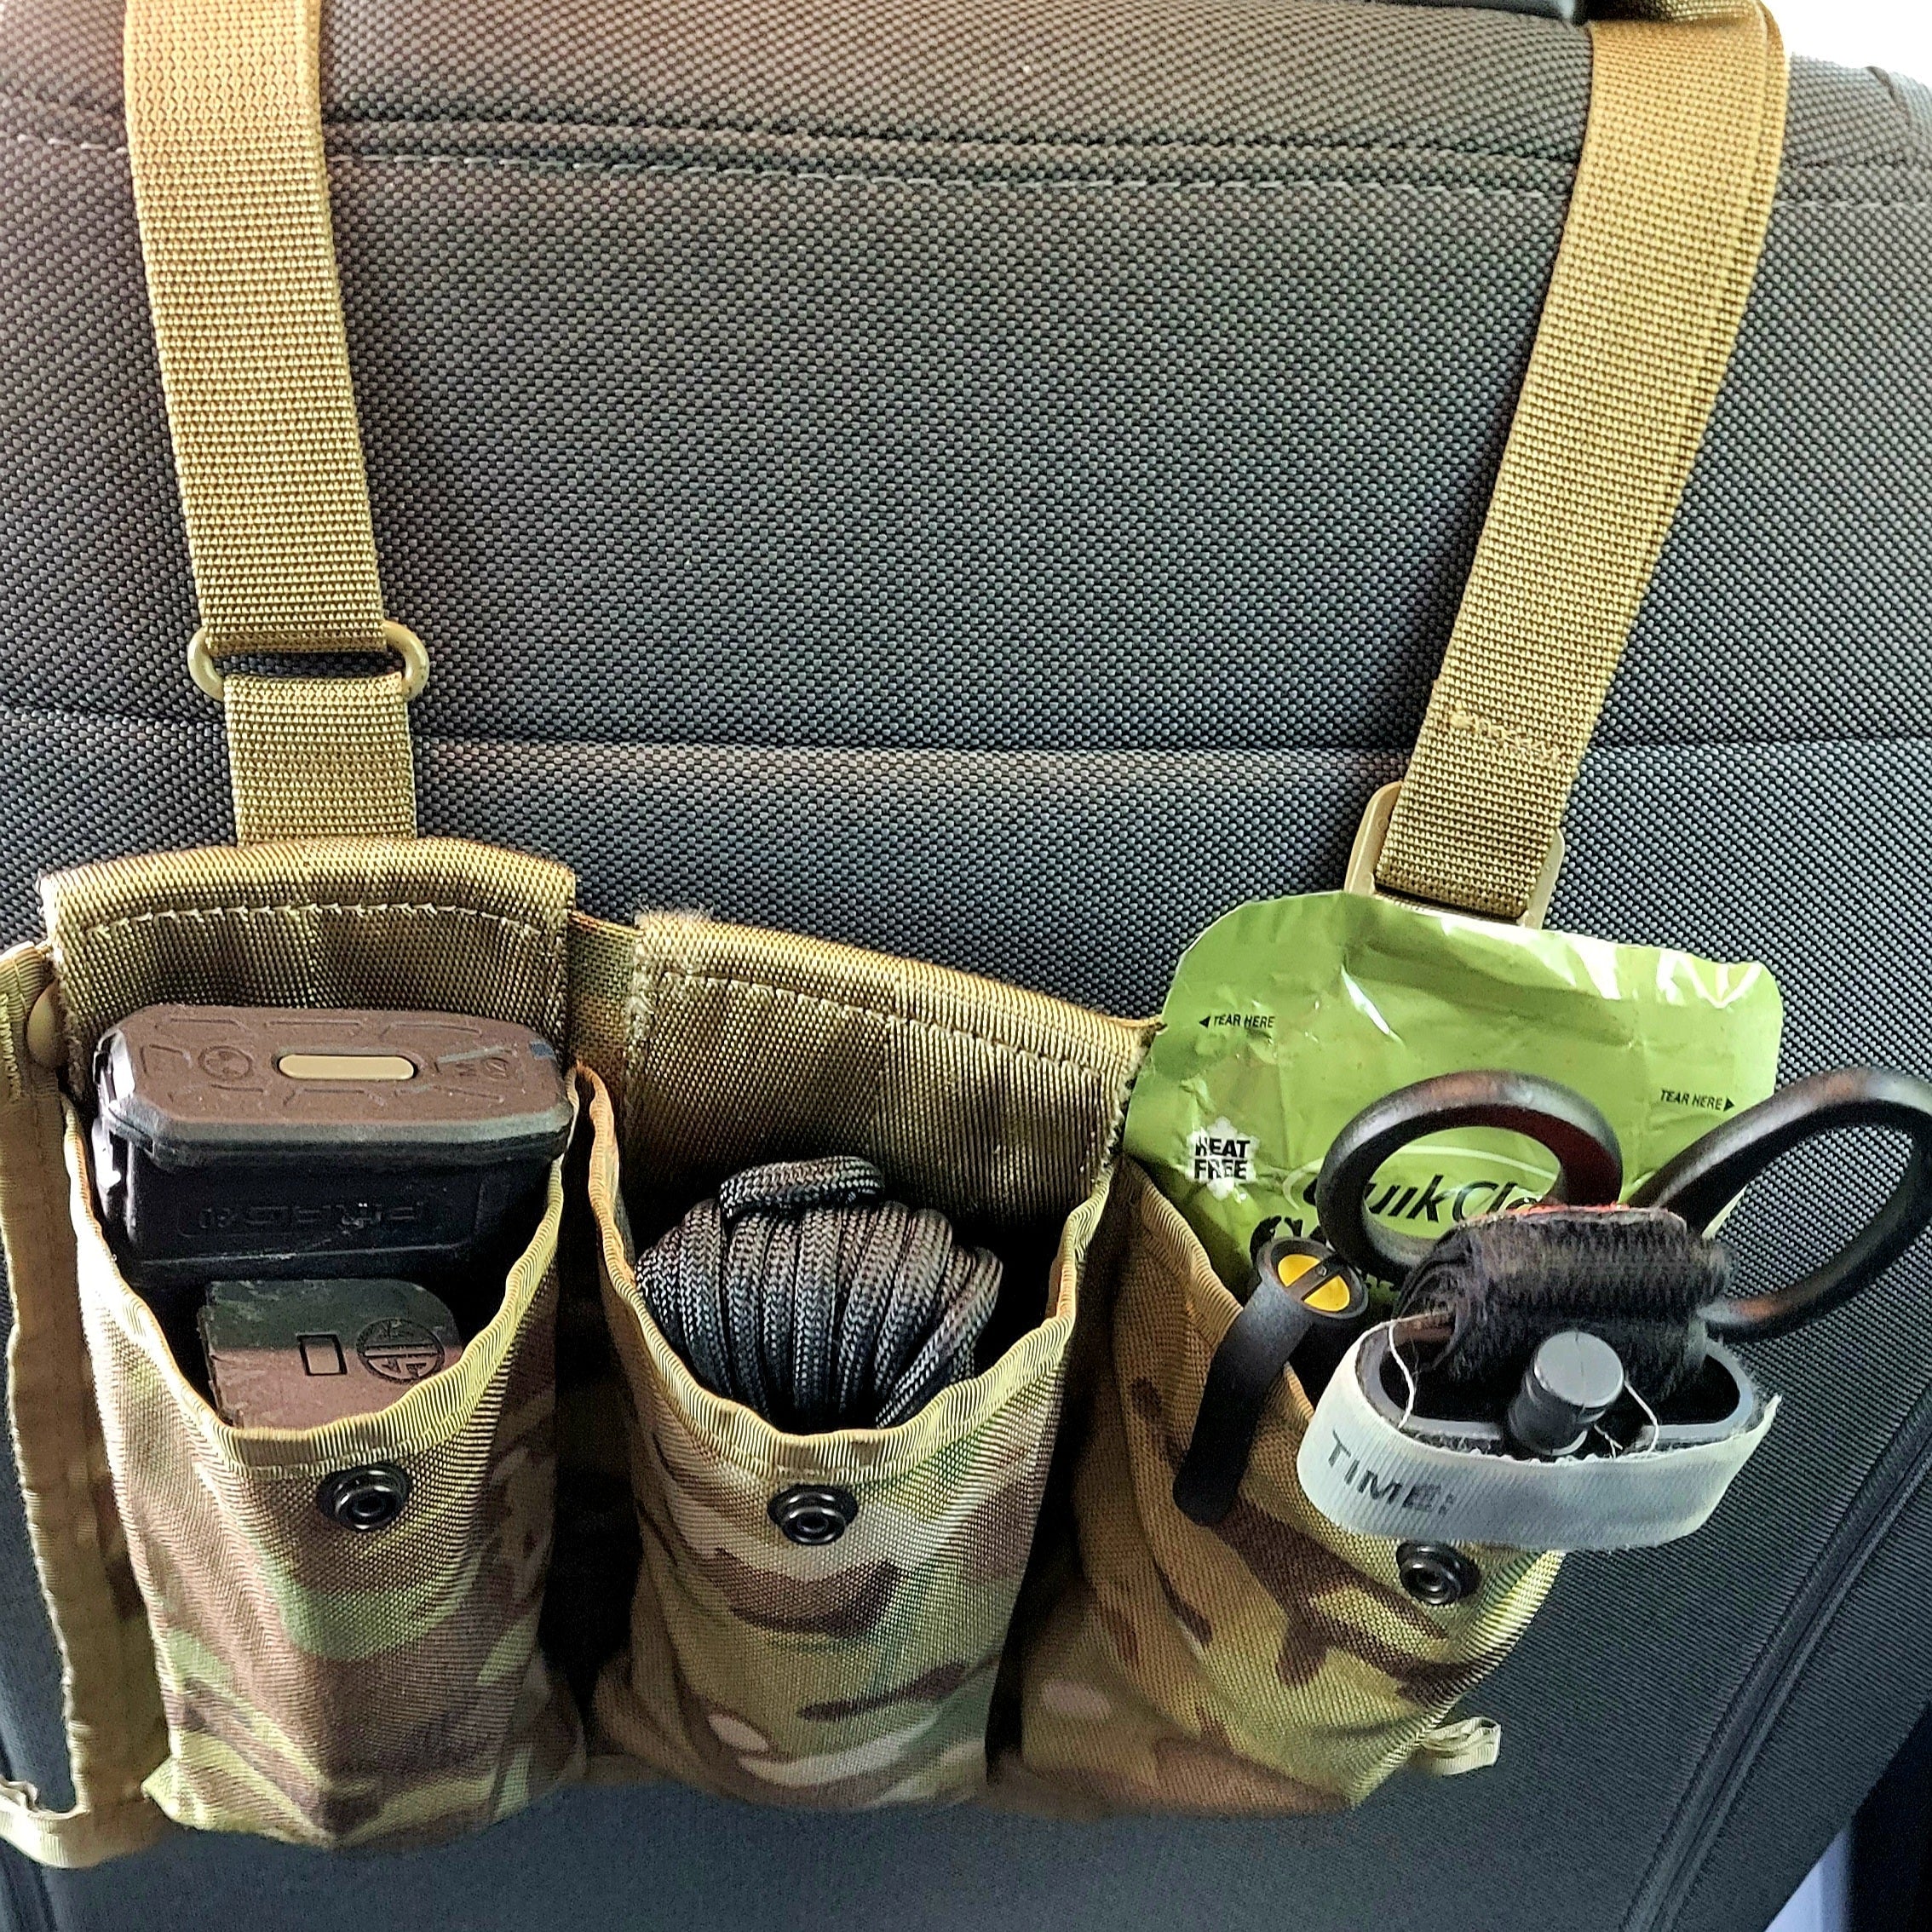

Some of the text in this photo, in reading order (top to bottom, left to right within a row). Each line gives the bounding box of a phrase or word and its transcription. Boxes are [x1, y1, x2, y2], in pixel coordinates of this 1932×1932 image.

[1213, 1014, 1275, 1028] TEAR HERE
[1660, 1089, 1722, 1111] TEAR HERE
[1195, 1136, 1251, 1159] HEAT
[1194, 1159, 1248, 1180] FREE
